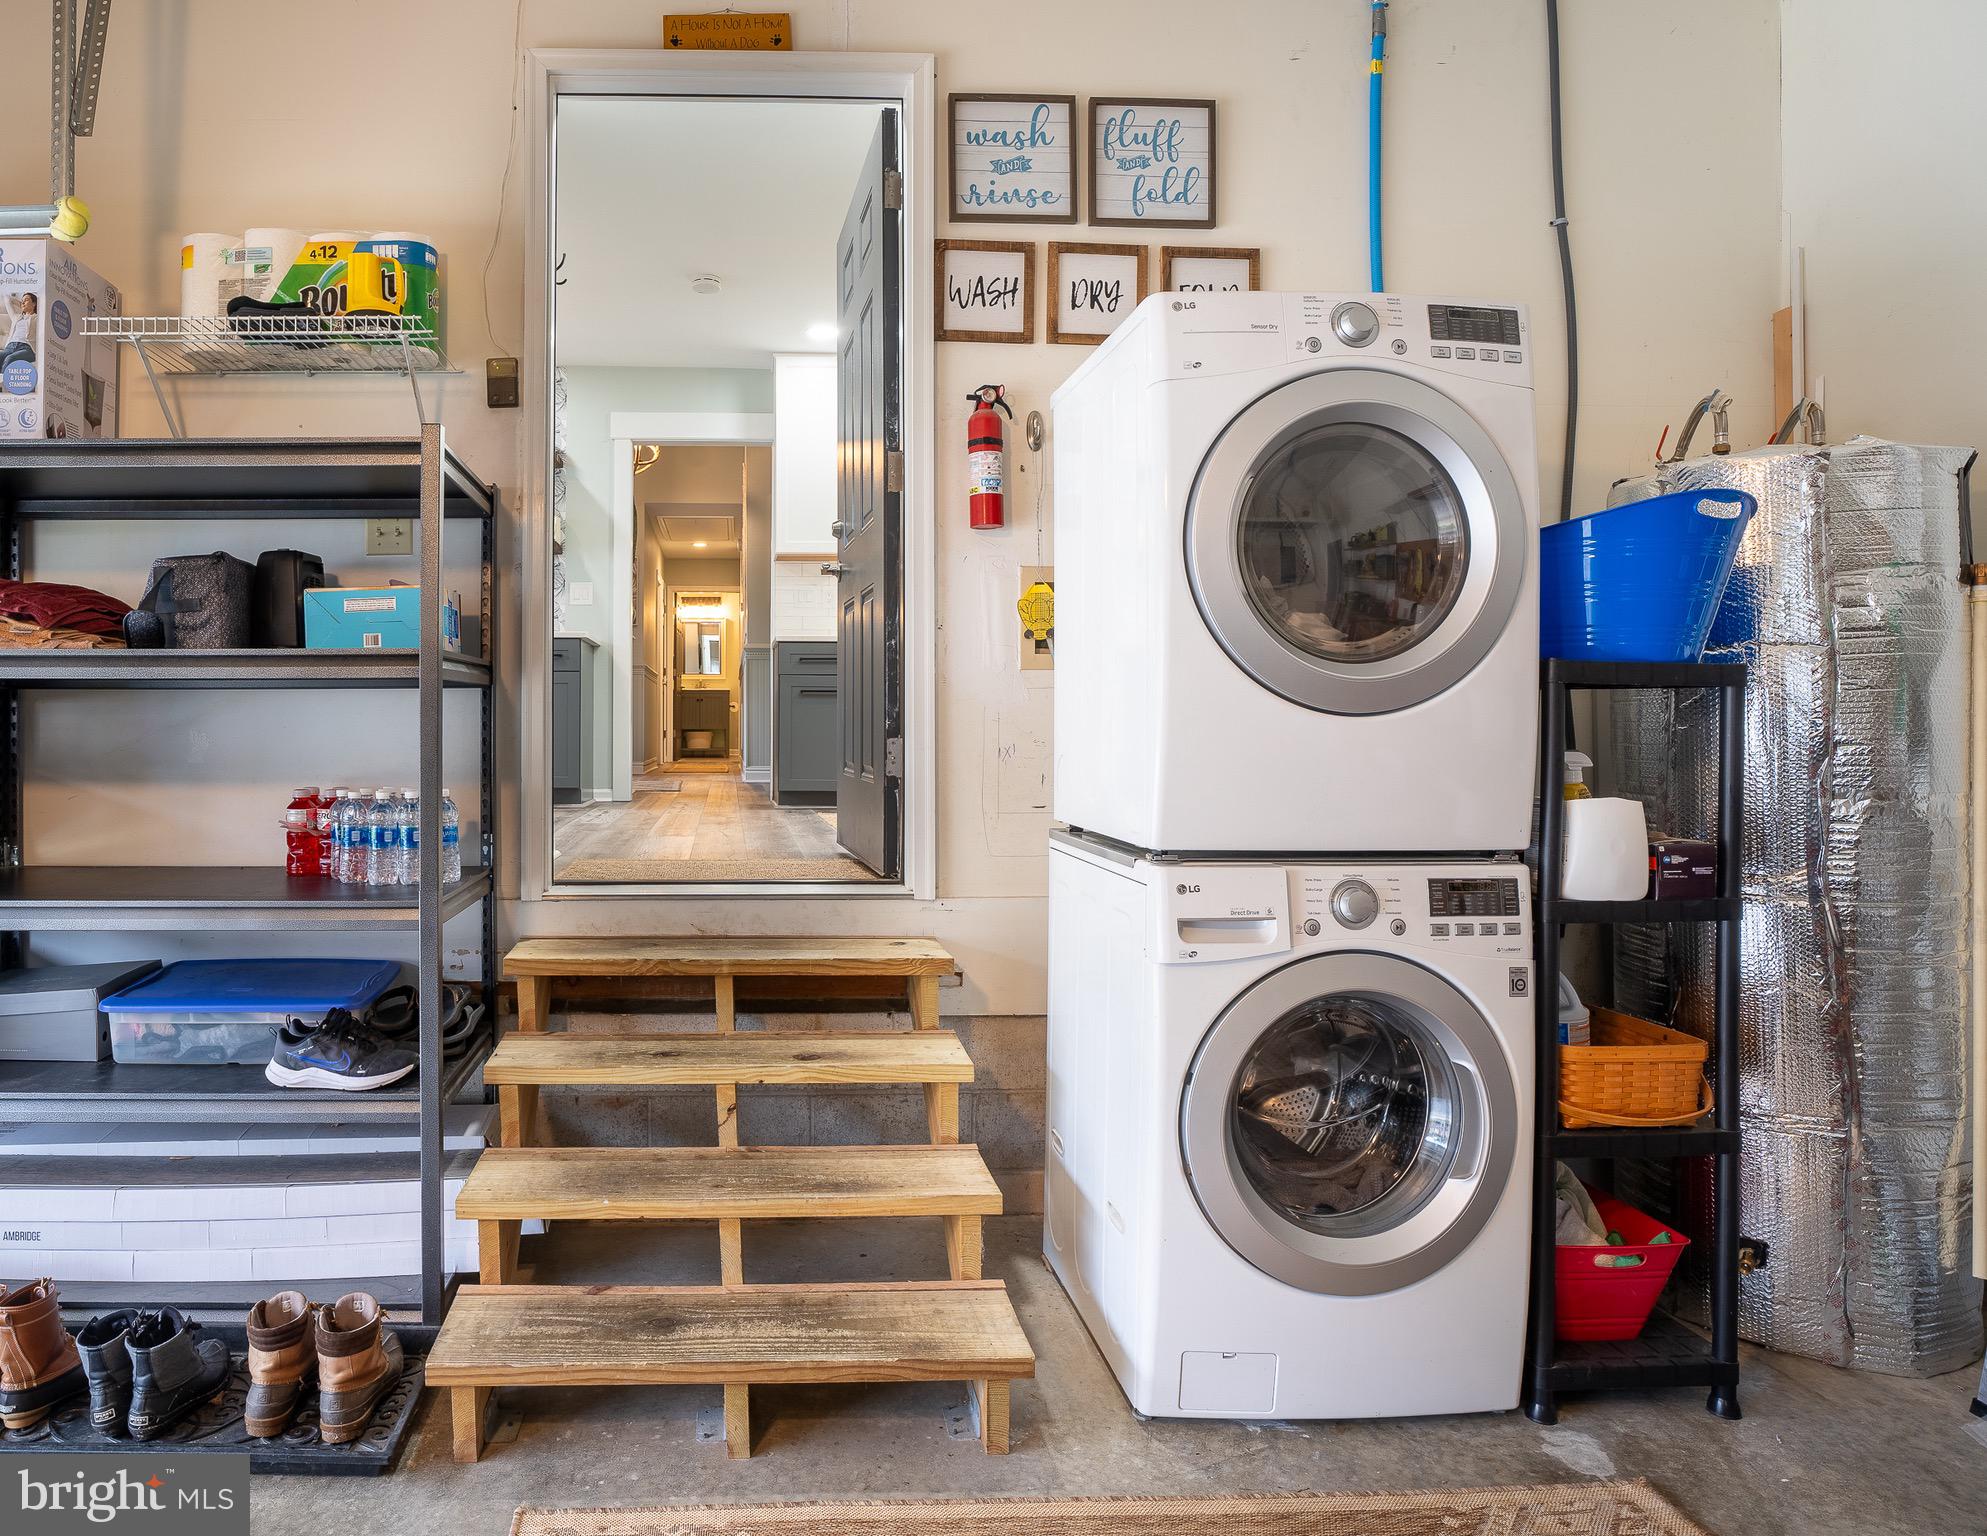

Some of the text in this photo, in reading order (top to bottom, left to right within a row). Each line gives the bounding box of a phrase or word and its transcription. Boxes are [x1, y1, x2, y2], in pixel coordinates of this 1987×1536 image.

[670, 20, 678, 31] A
[680, 18, 709, 32] House
[713, 19, 721, 30] Is
[723, 18, 741, 30] Not
[744, 19, 752, 29] A
[729, 39, 738, 49] A
[966, 103, 1055, 150] wash
[1103, 108, 1184, 162] fluff
[1000, 160, 1020, 173] AND
[1122, 159, 1142, 170] AND
[960, 180, 1062, 208] rinse
[1132, 166, 1200, 217] fold
[949, 274, 1019, 310] WASH
[1071, 278, 1124, 313] DRY
[3, 1231, 41, 1241] AMBRIDGE
